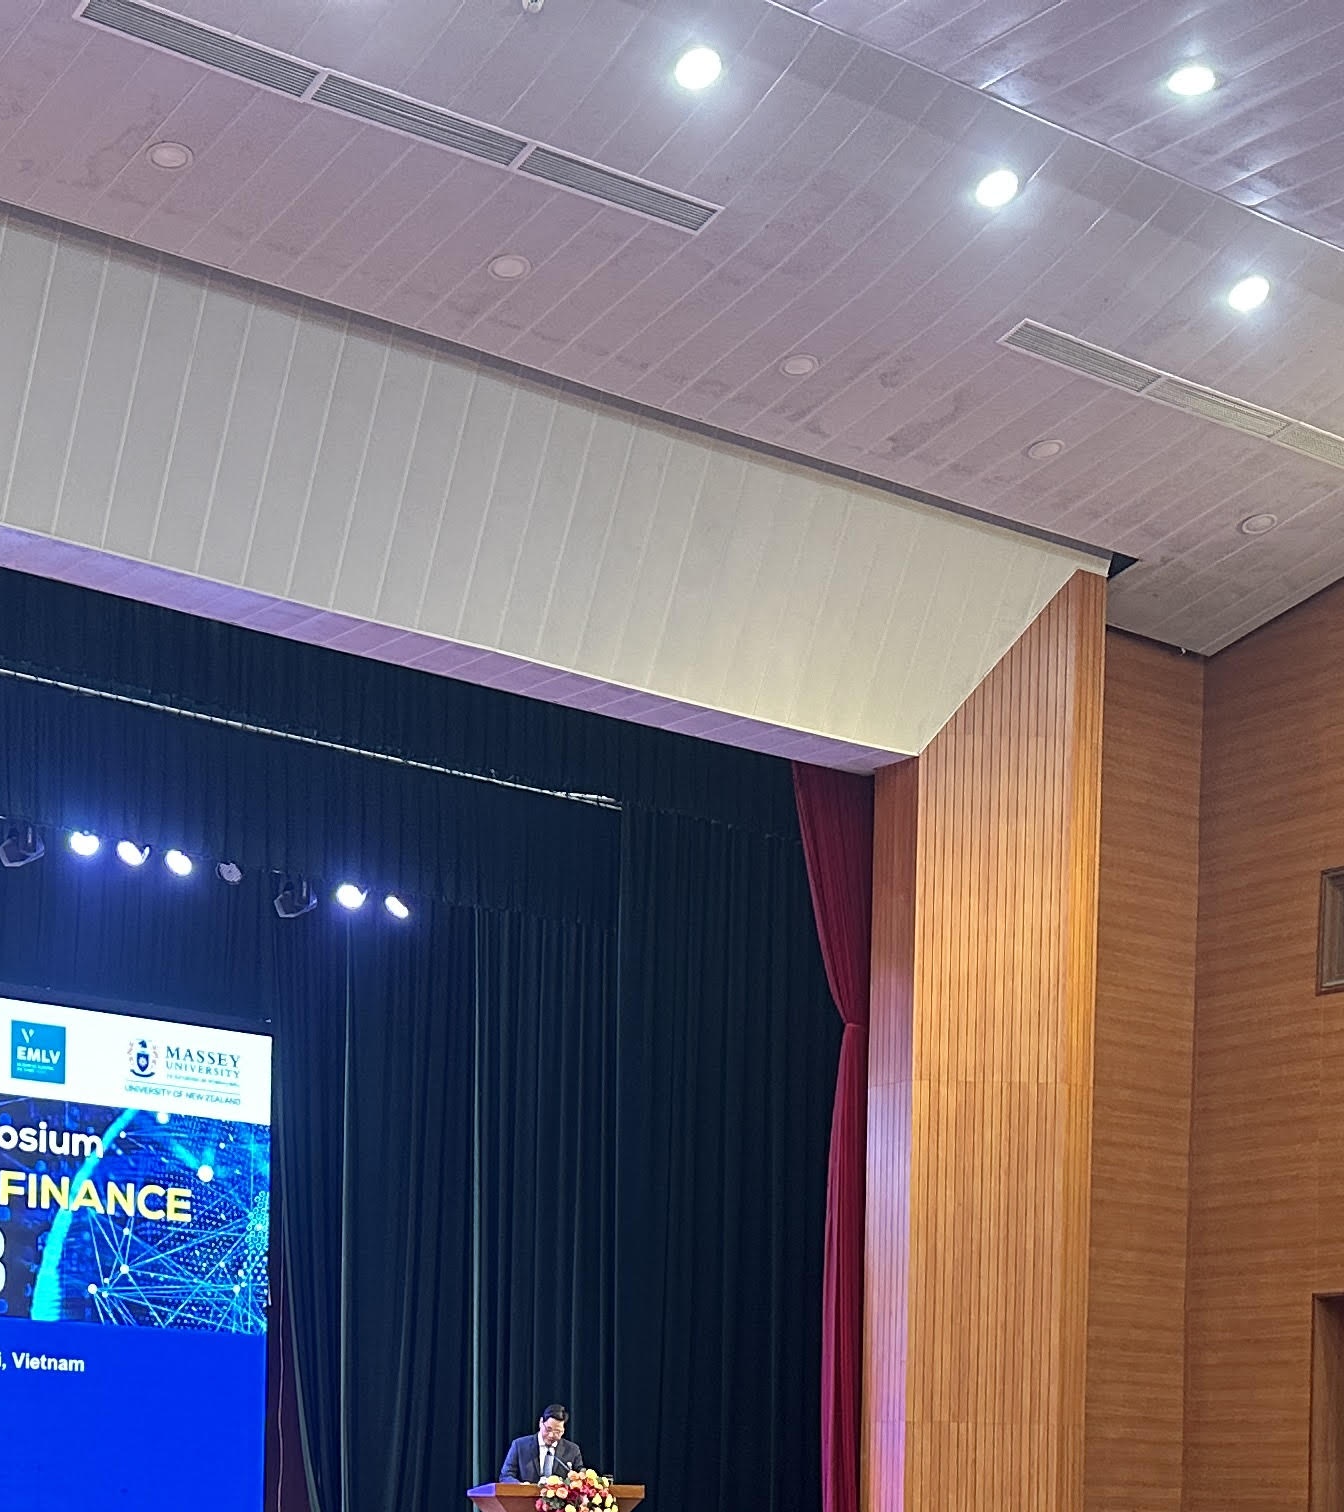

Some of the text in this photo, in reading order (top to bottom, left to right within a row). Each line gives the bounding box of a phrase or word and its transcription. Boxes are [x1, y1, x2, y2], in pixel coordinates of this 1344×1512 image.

[16, 1045, 61, 1065] EMLV
[166, 1046, 241, 1068] MASSEY
[165, 1060, 241, 1079] UNIVERSITY
[0, 1169, 193, 1223] FINANCE
[11, 1351, 86, 1373] Vietnam
